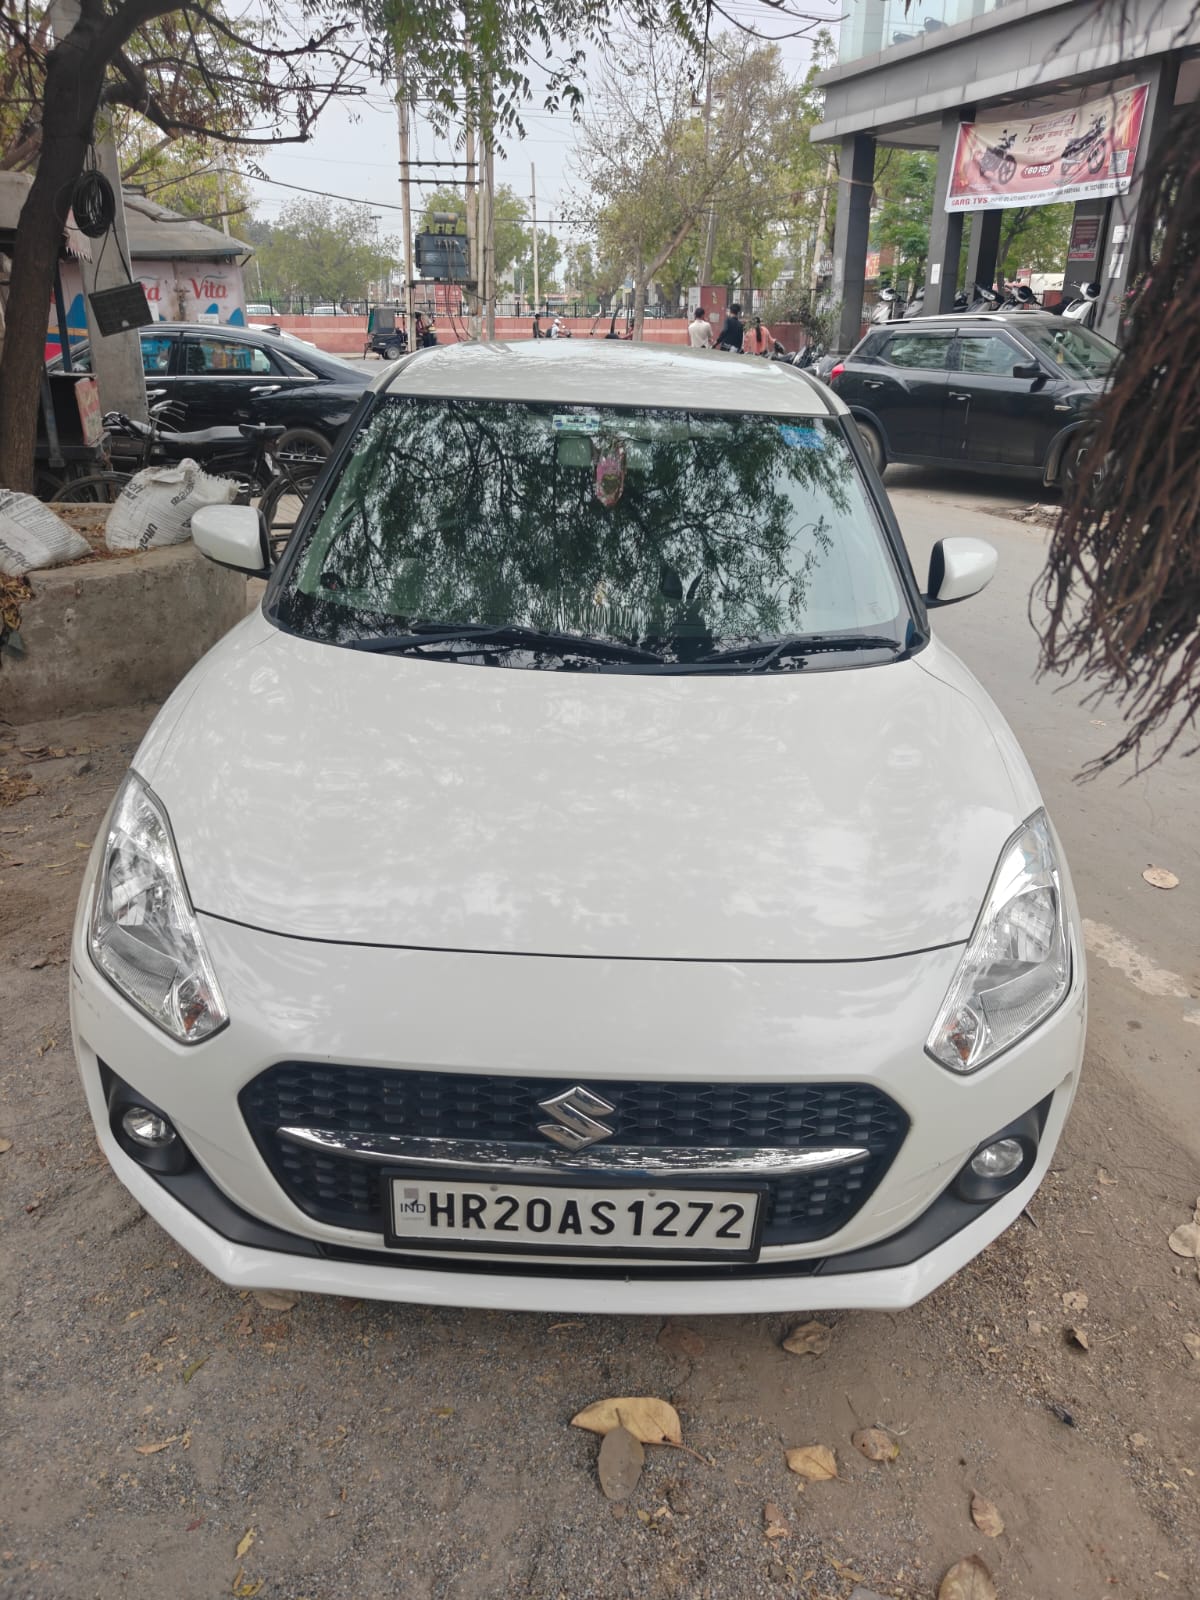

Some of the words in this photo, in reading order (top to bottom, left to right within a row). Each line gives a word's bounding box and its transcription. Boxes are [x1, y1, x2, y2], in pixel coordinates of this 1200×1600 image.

[972, 197, 988, 205] TVS
[189, 277, 228, 299] Vita
[400, 1202, 426, 1213] IND
[429, 1191, 745, 1239] HR20AS1272
